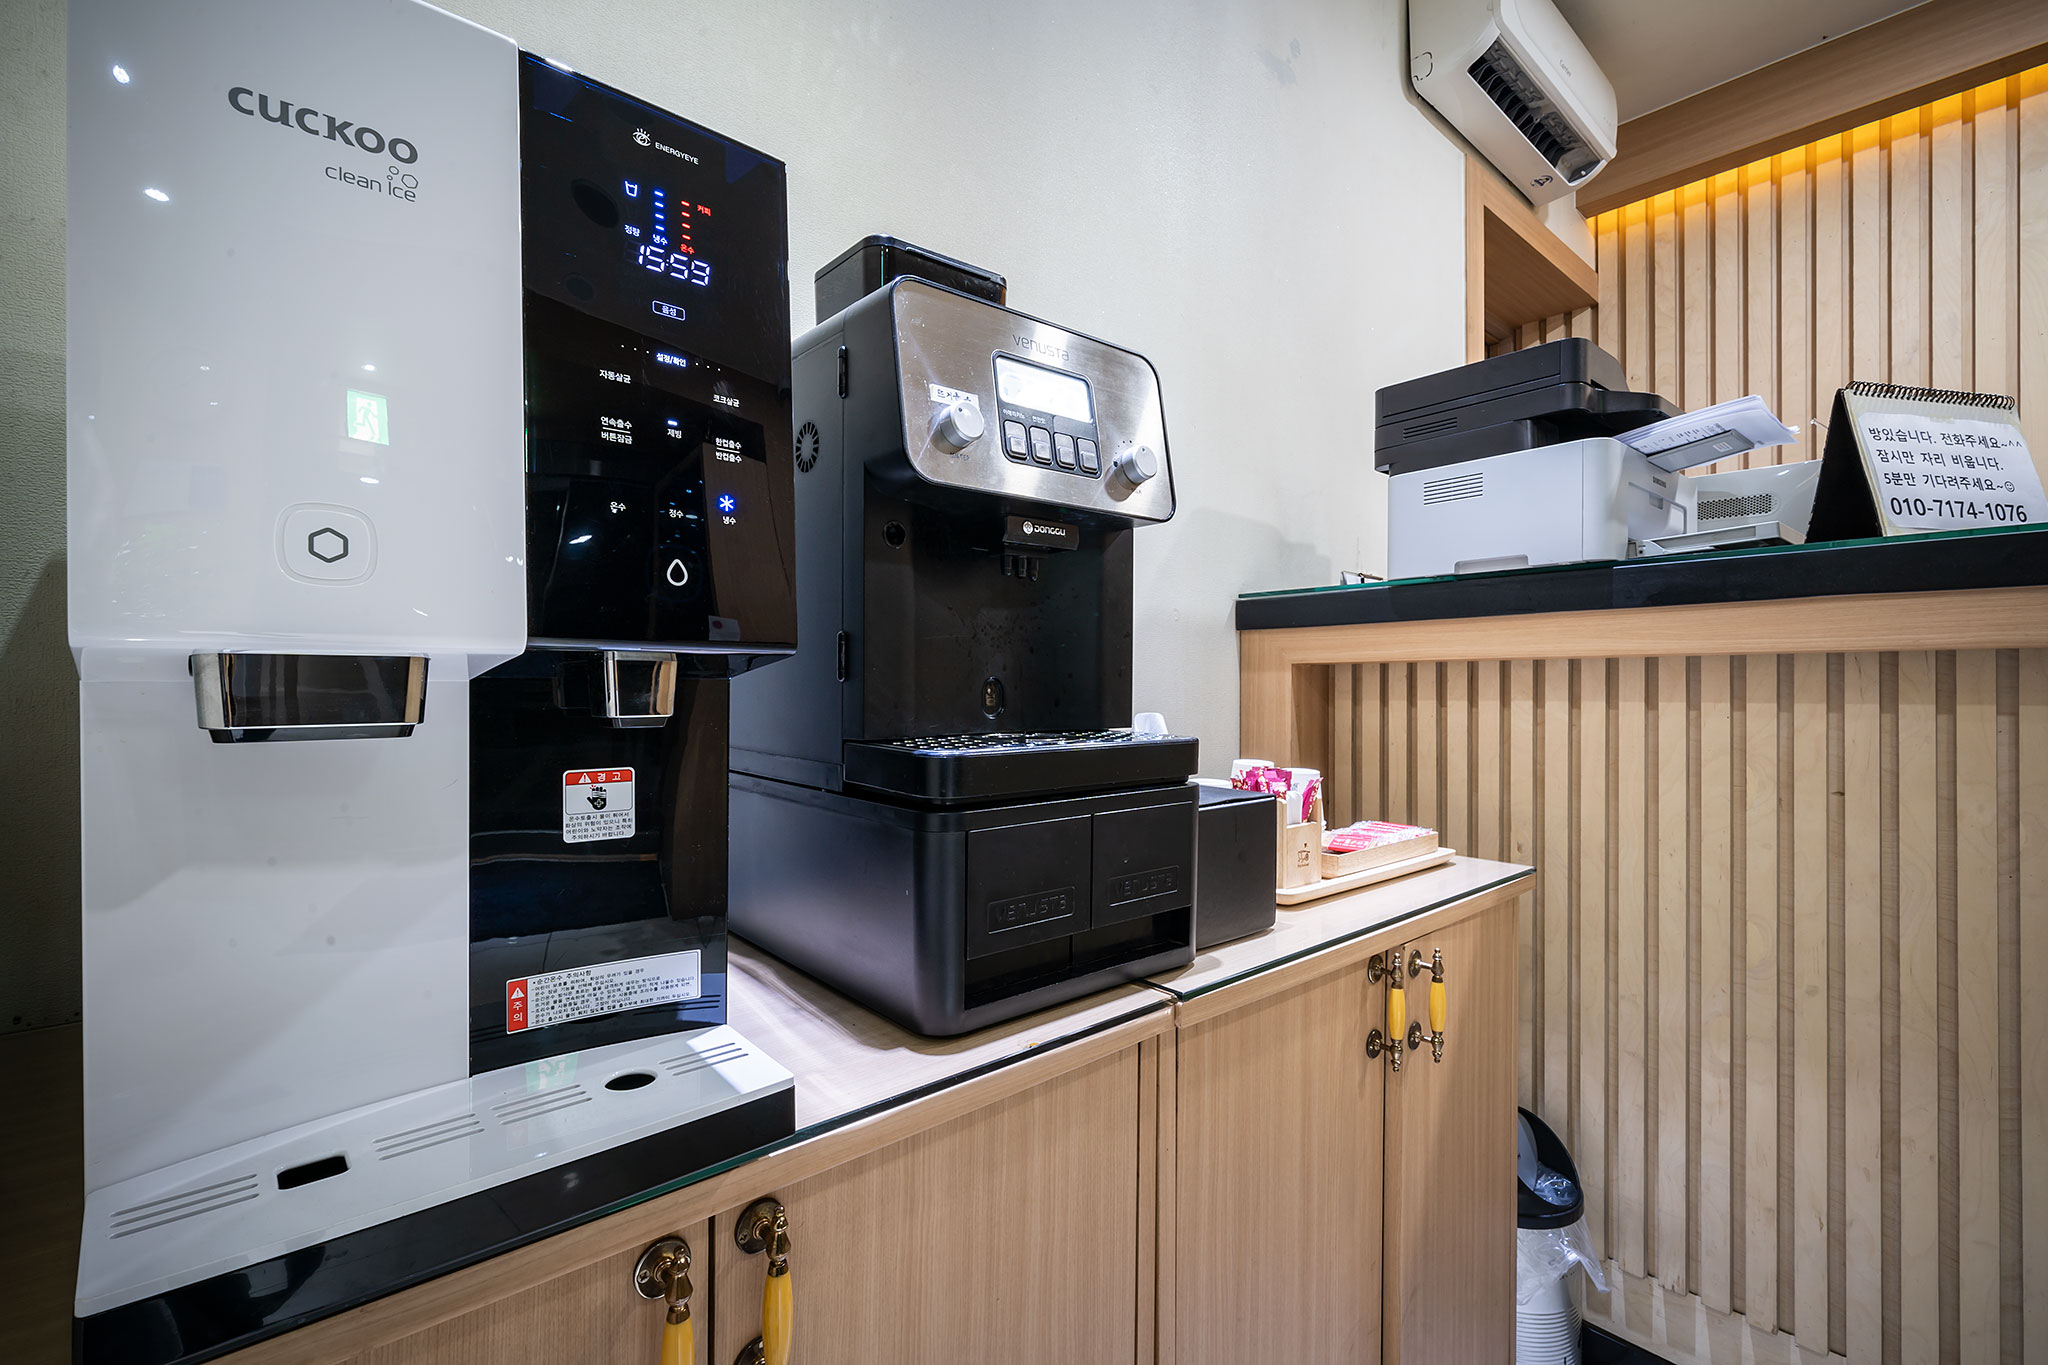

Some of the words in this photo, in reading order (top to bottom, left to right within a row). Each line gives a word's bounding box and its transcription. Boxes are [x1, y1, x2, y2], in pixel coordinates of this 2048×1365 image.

[227, 86, 419, 165] CUCKOO
[654, 141, 699, 165] ENERGYEYE
[324, 163, 382, 193] clean
[388, 175, 417, 204] ice
[696, 204, 712, 216] 커피
[652, 234, 668, 246] 냉수
[680, 243, 696, 255] 온수
[638, 244, 711, 287] 15:59
[661, 306, 677, 316] 음성
[656, 352, 687, 367] 설정/확인
[599, 369, 632, 384] 자동살균
[600, 416, 632, 430] 연속출수
[600, 431, 632, 445] 버튼잠금
[667, 428, 682, 439] 제빙
[1868, 428, 1936, 444] 방있습니다.
[716, 438, 742, 450] 한컵출수
[716, 451, 742, 464] 반컵출수
[1876, 449, 1916, 464] 잠시만
[1920, 452, 1946, 467] 자리
[1952, 455, 2004, 471] 비웁니다.
[1884, 472, 1916, 486] 5분만
[669, 509, 684, 519] 정수
[1890, 497, 2028, 523] 010-7174-1076
[722, 516, 737, 526] 냉수
